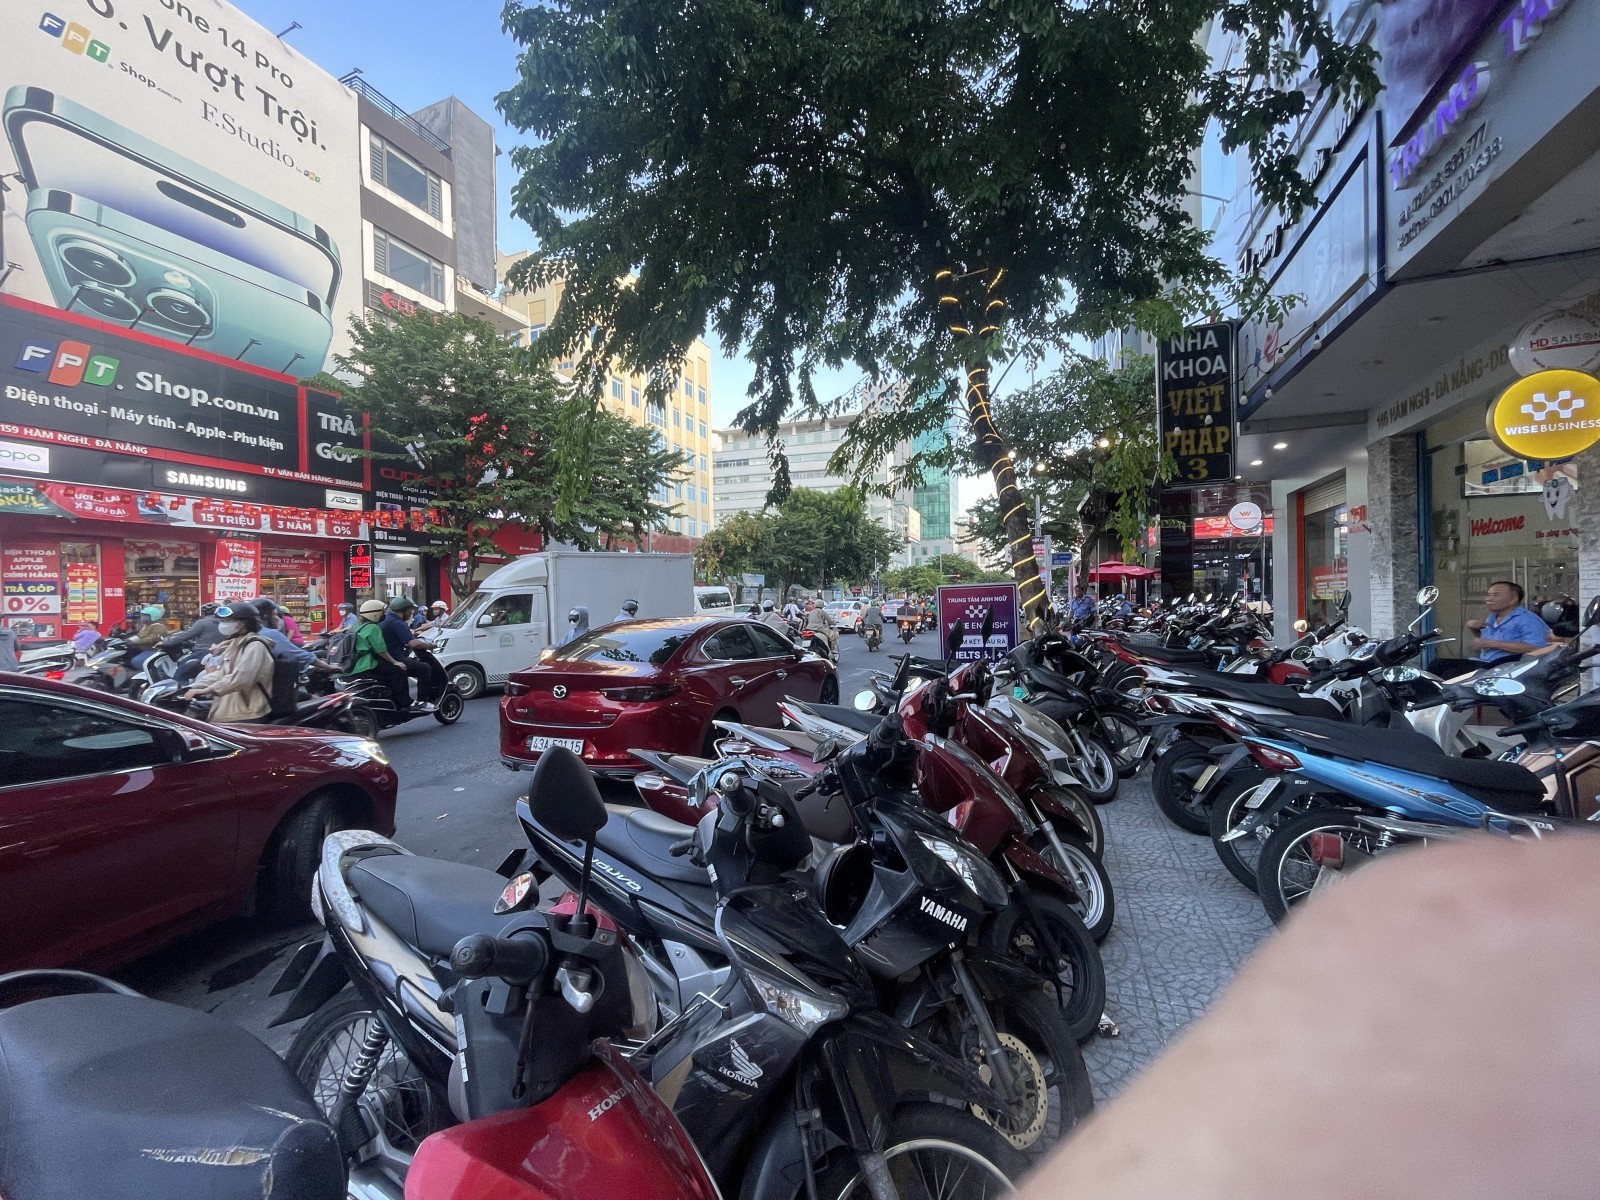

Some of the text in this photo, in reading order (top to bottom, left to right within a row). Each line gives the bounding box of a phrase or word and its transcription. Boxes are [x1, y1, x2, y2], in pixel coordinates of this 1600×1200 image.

[218, 27, 247, 58] 14
[255, 50, 293, 89] Pro
[142, 13, 245, 102] Vượt
[255, 85, 326, 151] Trội.
[200, 99, 295, 168] F.Studio
[1530, 338, 1549, 349] HD
[1163, 354, 1228, 381] KHOA
[135, 371, 280, 421] Shop.com.vn
[5, 385, 50, 406] Điện
[53, 396, 98, 417] thoại
[110, 406, 144, 425] Máy
[147, 412, 176, 430] tính
[186, 422, 226, 441] Apple
[233, 431, 257, 448] Phụ
[258, 432, 284, 451] kiện
[316, 411, 357, 437] TRẢ
[1504, 418, 1600, 436] WISE BUSINESS
[0, 424, 19, 434] 159
[24, 427, 54, 440] HÀM
[95, 437, 114, 449] ĐÀ
[294, 472, 310, 480] BÁN
[1187, 458, 1209, 480] 3
[166, 470, 248, 492] SAMSUNG
[330, 495, 359, 506] ASUS
[201, 513, 255, 527] 15 TRIỆU
[277, 520, 312, 531] 3 NĂM
[332, 525, 352, 535] 0%
[1470, 515, 1525, 537] Welcome
[4, 583, 55, 593] TRẢ GÓP
[8, 597, 50, 612] 0%
[948, 621, 1007, 630] WE ENISH
[955, 650, 981, 660] IELTS
[919, 895, 968, 932] YAMAHA
[718, 1066, 759, 1089] HONDA
